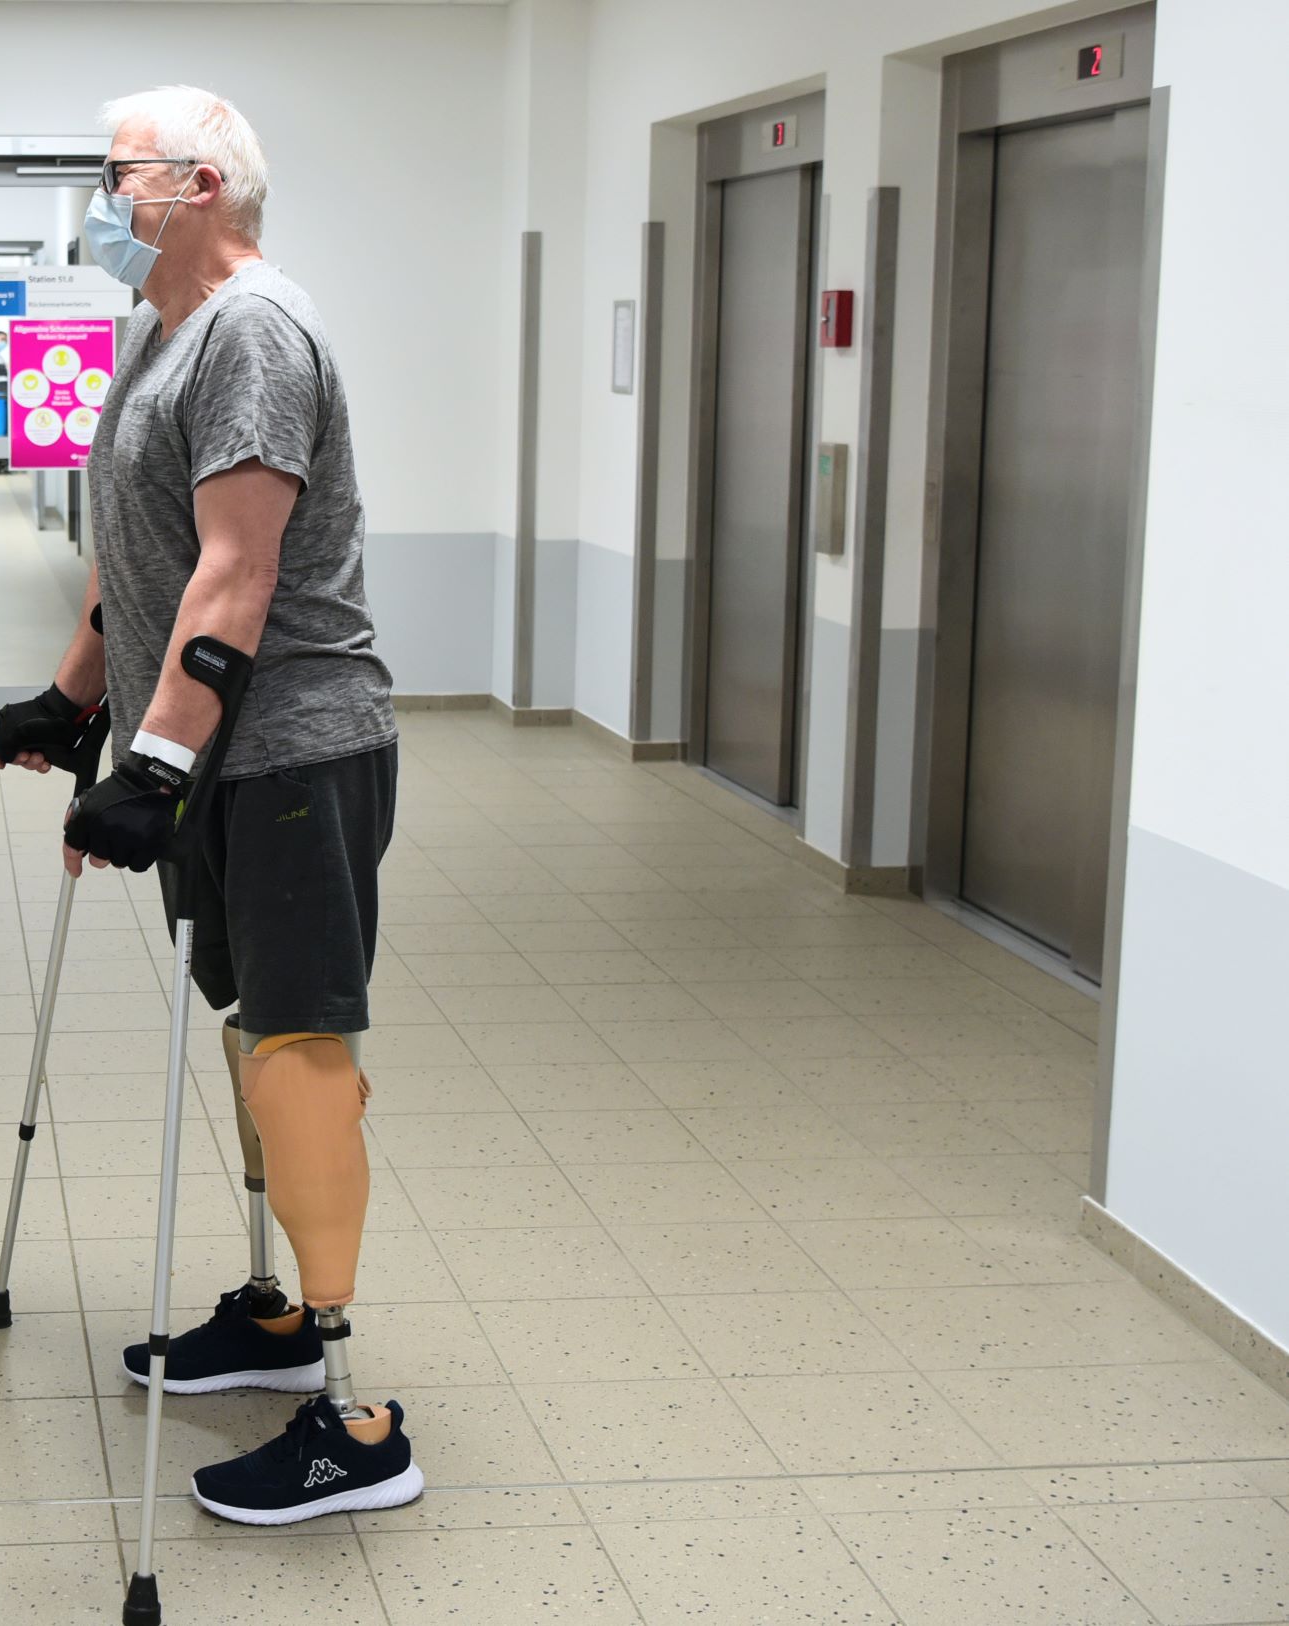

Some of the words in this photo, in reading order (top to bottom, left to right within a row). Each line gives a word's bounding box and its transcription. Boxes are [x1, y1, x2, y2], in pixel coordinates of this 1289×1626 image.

[1091, 47, 1102, 75] 2
[28, 275, 56, 283] Station
[148, 765, 181, 785] CHIBA
